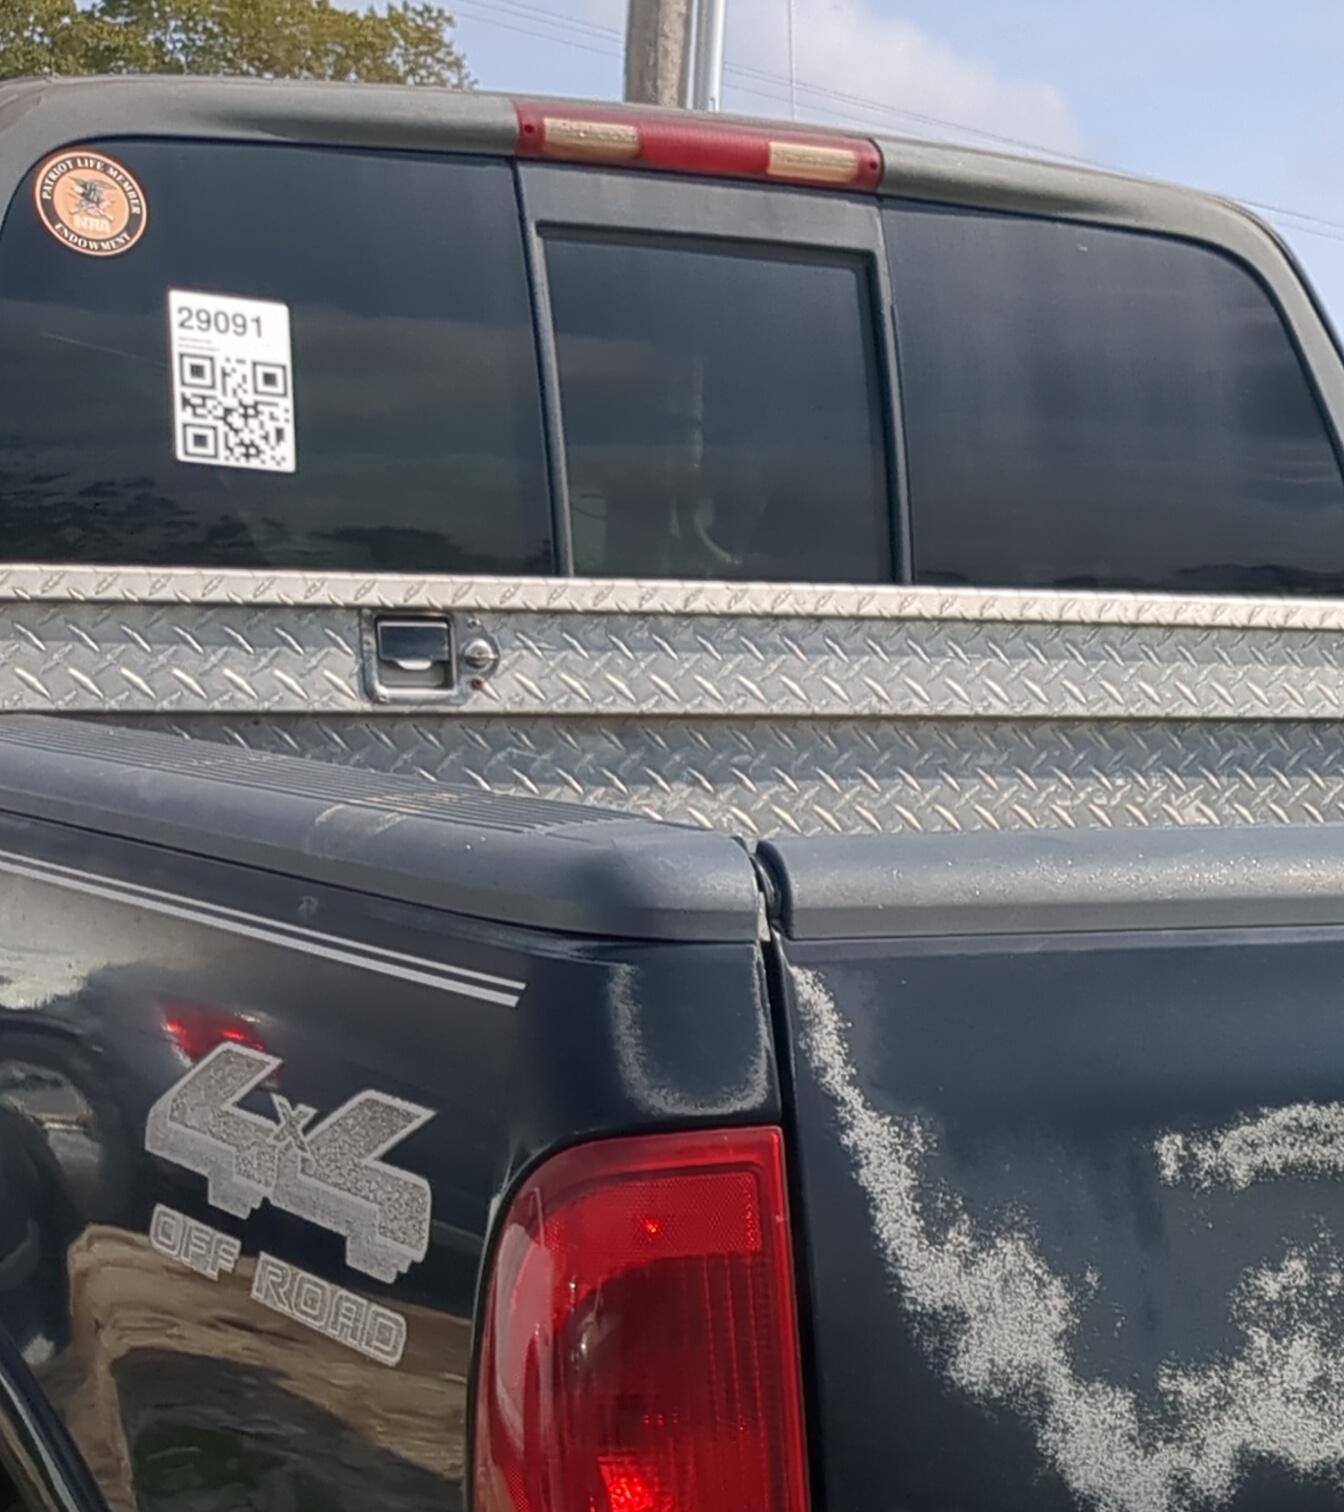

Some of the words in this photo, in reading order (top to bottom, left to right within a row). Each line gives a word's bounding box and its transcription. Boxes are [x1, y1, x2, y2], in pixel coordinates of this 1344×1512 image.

[42, 159, 74, 200] PATRIOT
[77, 158, 104, 171] LIFE
[106, 167, 140, 215] MEMBER
[55, 223, 131, 250] ENDOWMENT
[178, 306, 262, 338] 29091
[150, 1203, 242, 1280] OFF
[250, 1251, 407, 1367] ROAD
